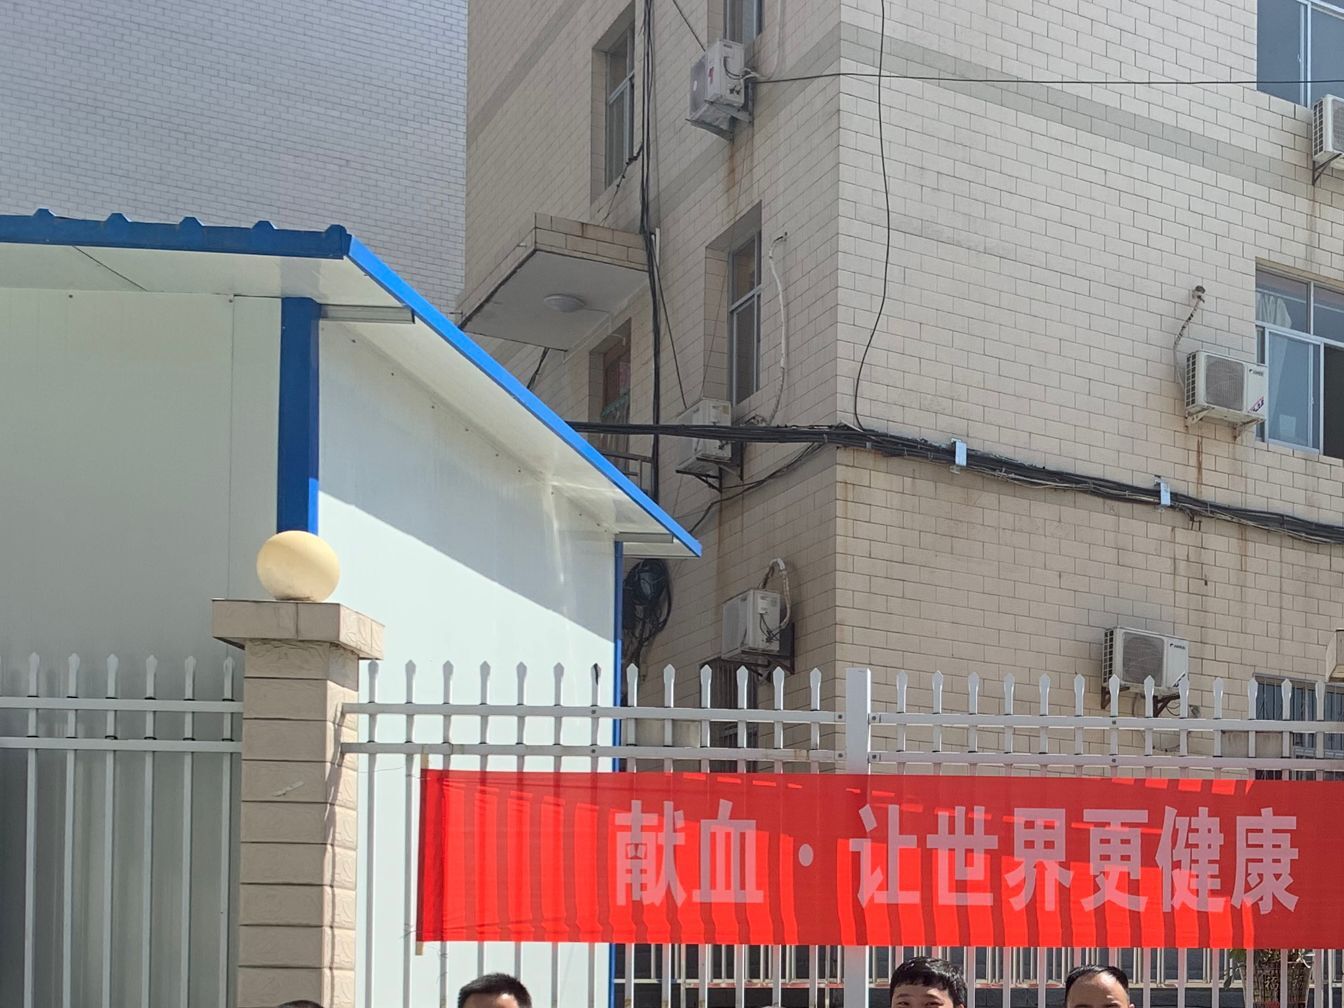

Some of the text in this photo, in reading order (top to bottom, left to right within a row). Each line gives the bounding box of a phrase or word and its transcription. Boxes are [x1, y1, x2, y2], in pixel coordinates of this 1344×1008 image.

[614, 799, 1300, 915] 献血·让世界更健康
